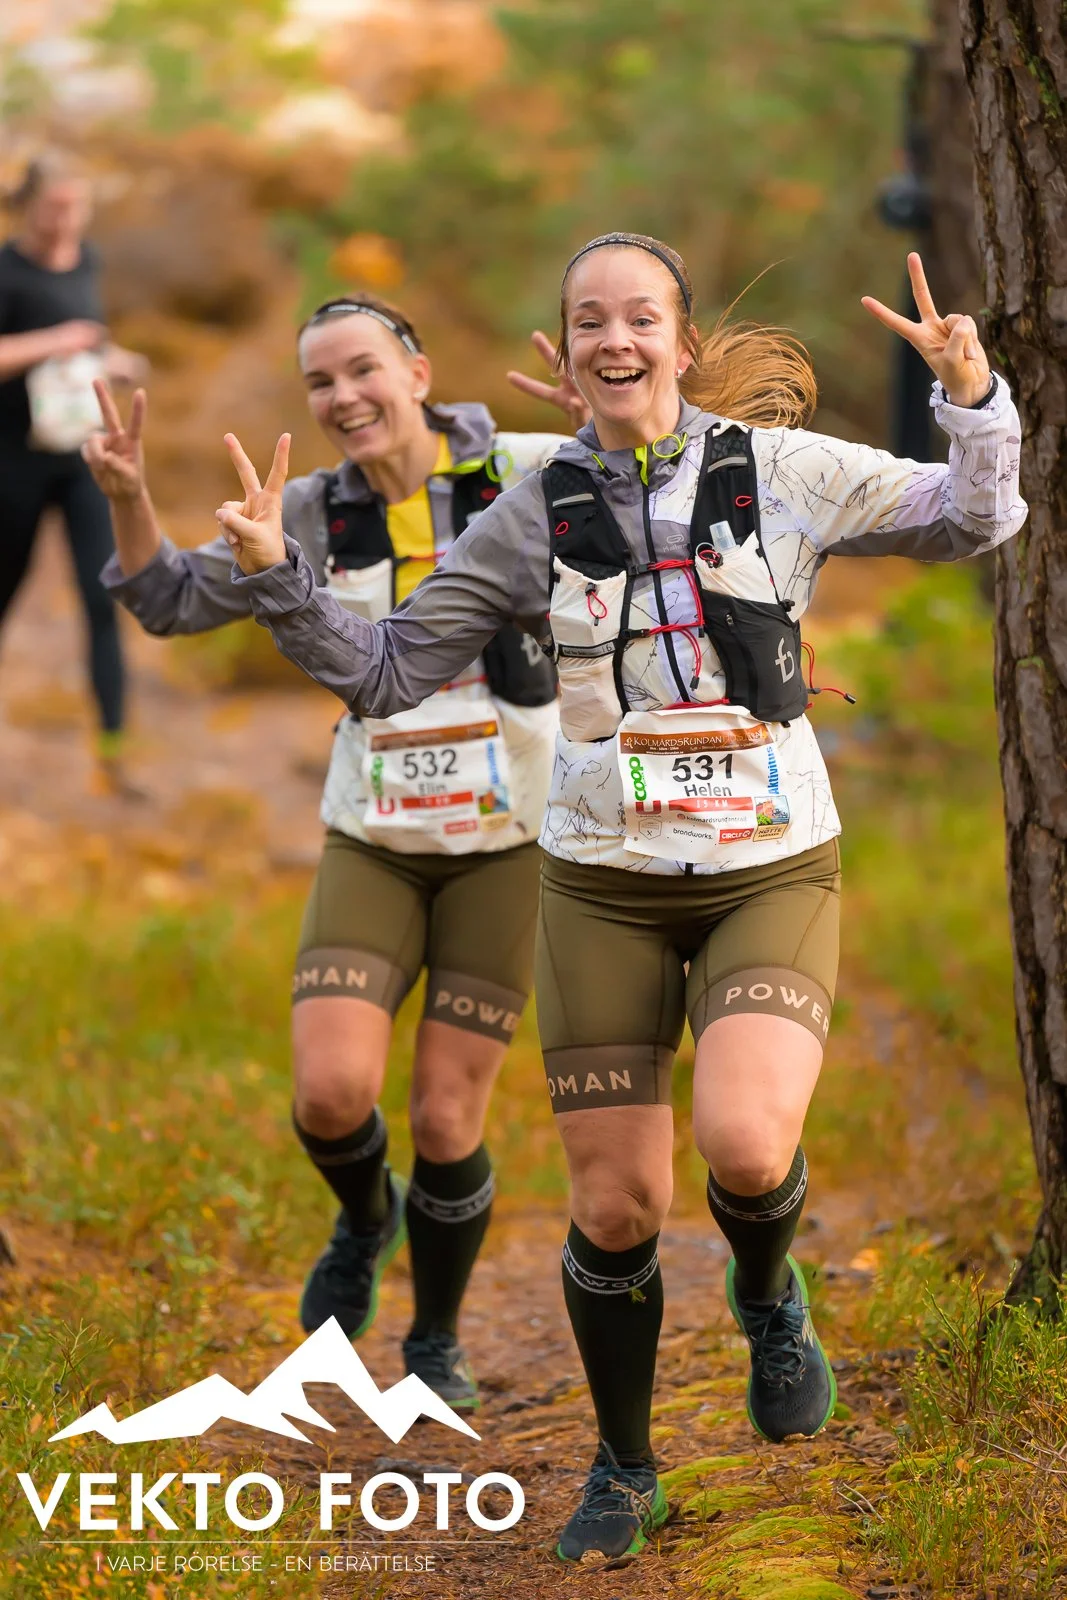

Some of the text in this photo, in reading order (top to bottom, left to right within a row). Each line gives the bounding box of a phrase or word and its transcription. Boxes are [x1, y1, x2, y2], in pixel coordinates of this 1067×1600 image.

[404, 748, 458, 779] 532
[671, 753, 733, 782] 531
[629, 757, 646, 800] coop
[684, 783, 732, 797] Helen
[291, 965, 368, 994] OMAN
[434, 990, 521, 1031] POWE
[547, 1069, 632, 1098] OMAN
